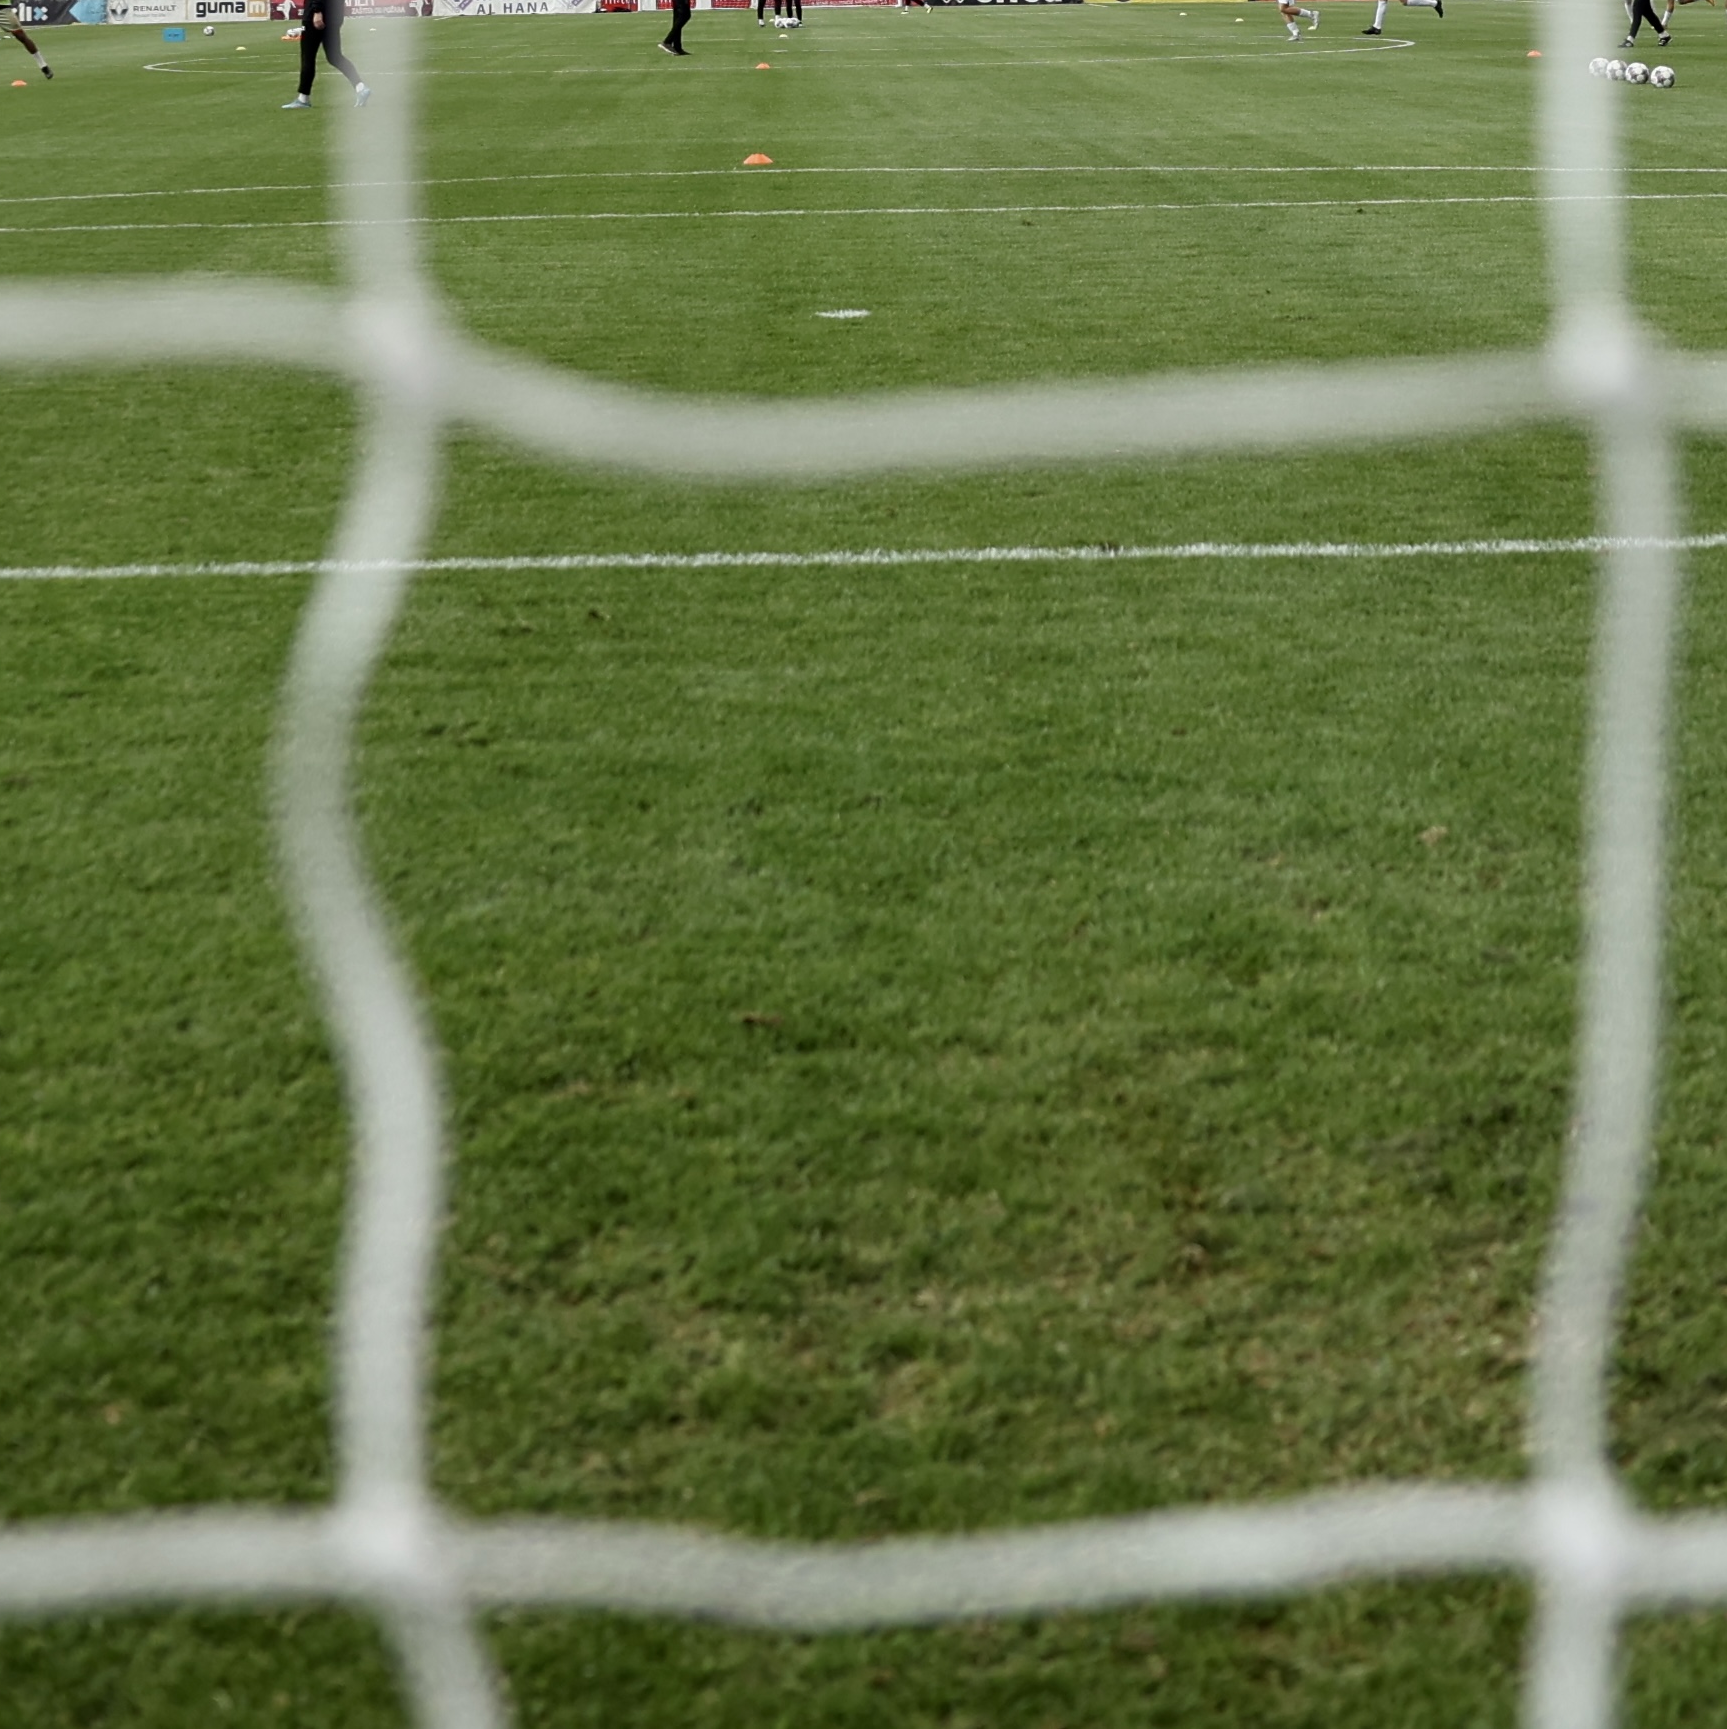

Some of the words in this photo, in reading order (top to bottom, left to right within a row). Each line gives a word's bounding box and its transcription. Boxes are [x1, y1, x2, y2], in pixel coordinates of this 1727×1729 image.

[11, 2, 49, 22] lix
[476, 3, 495, 14] AL
[503, 2, 549, 14] HANA
